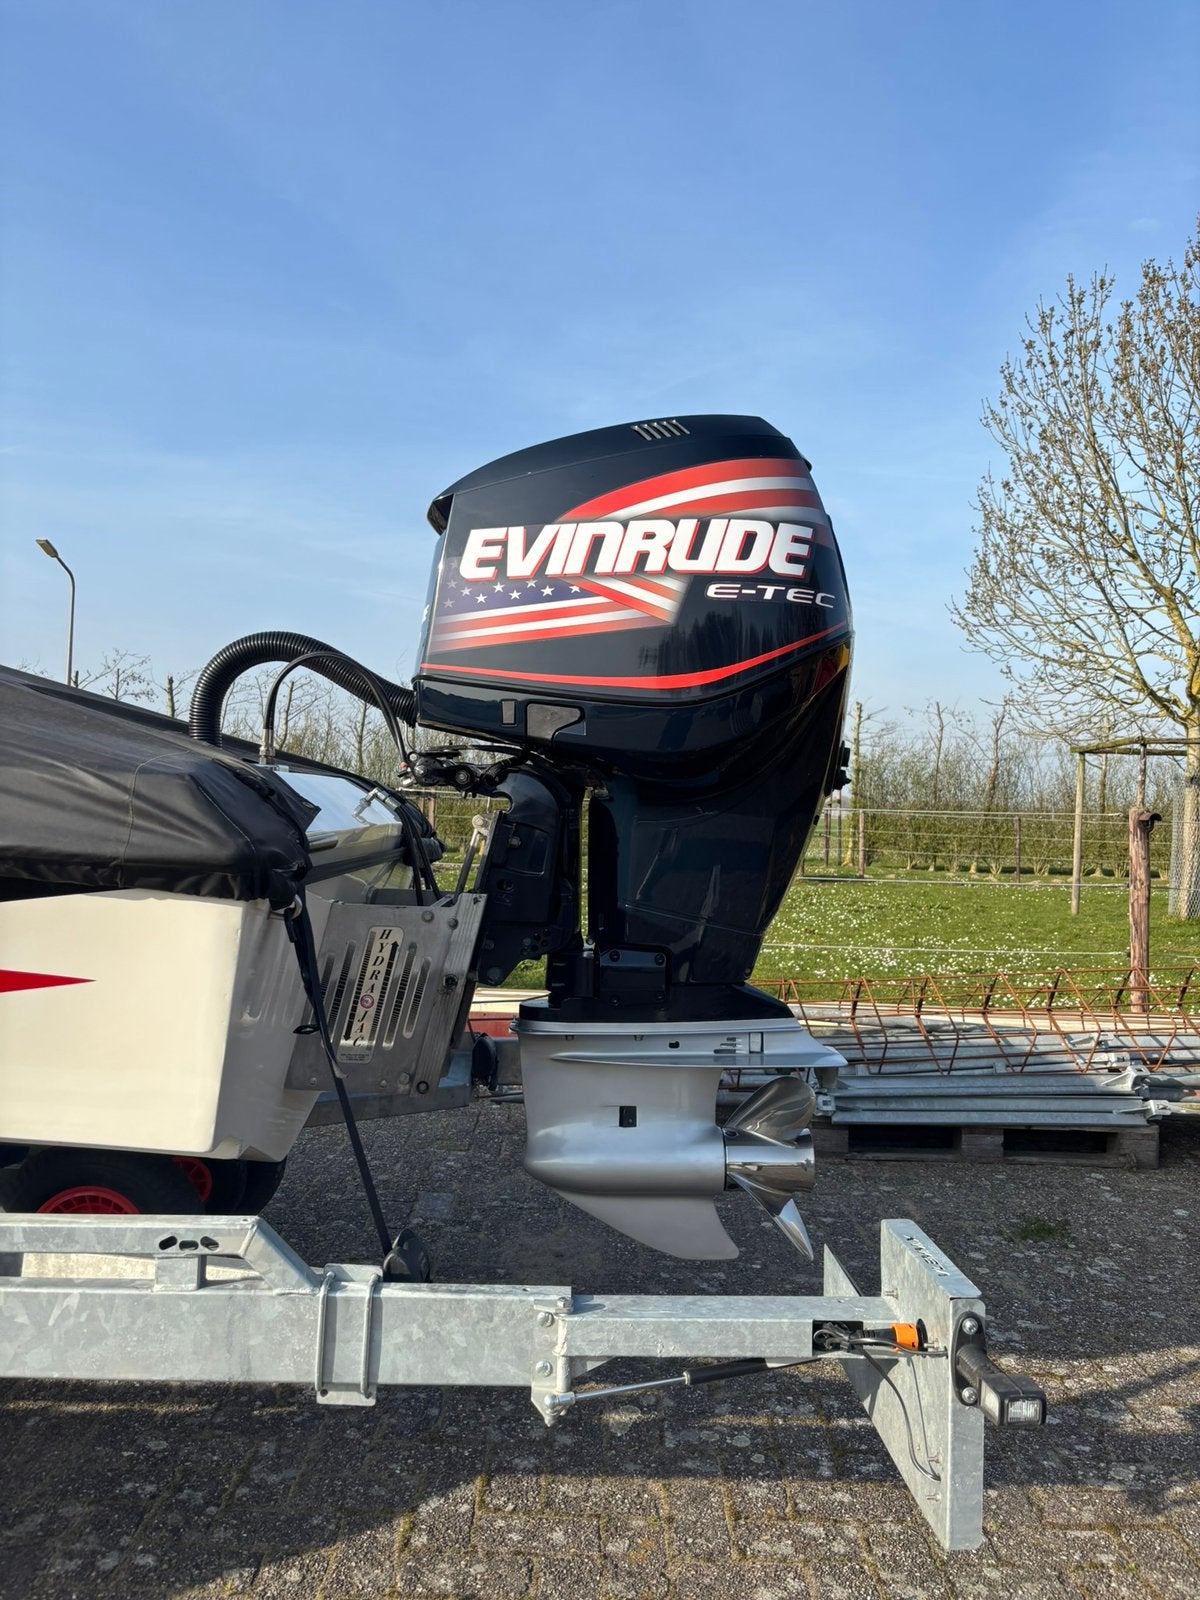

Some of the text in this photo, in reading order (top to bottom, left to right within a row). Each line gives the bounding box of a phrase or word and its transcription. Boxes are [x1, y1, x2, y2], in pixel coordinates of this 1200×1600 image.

[459, 519, 815, 582] EVINRUDE
[706, 583, 836, 608] E-TEC
[366, 929, 392, 993] HYDRA
